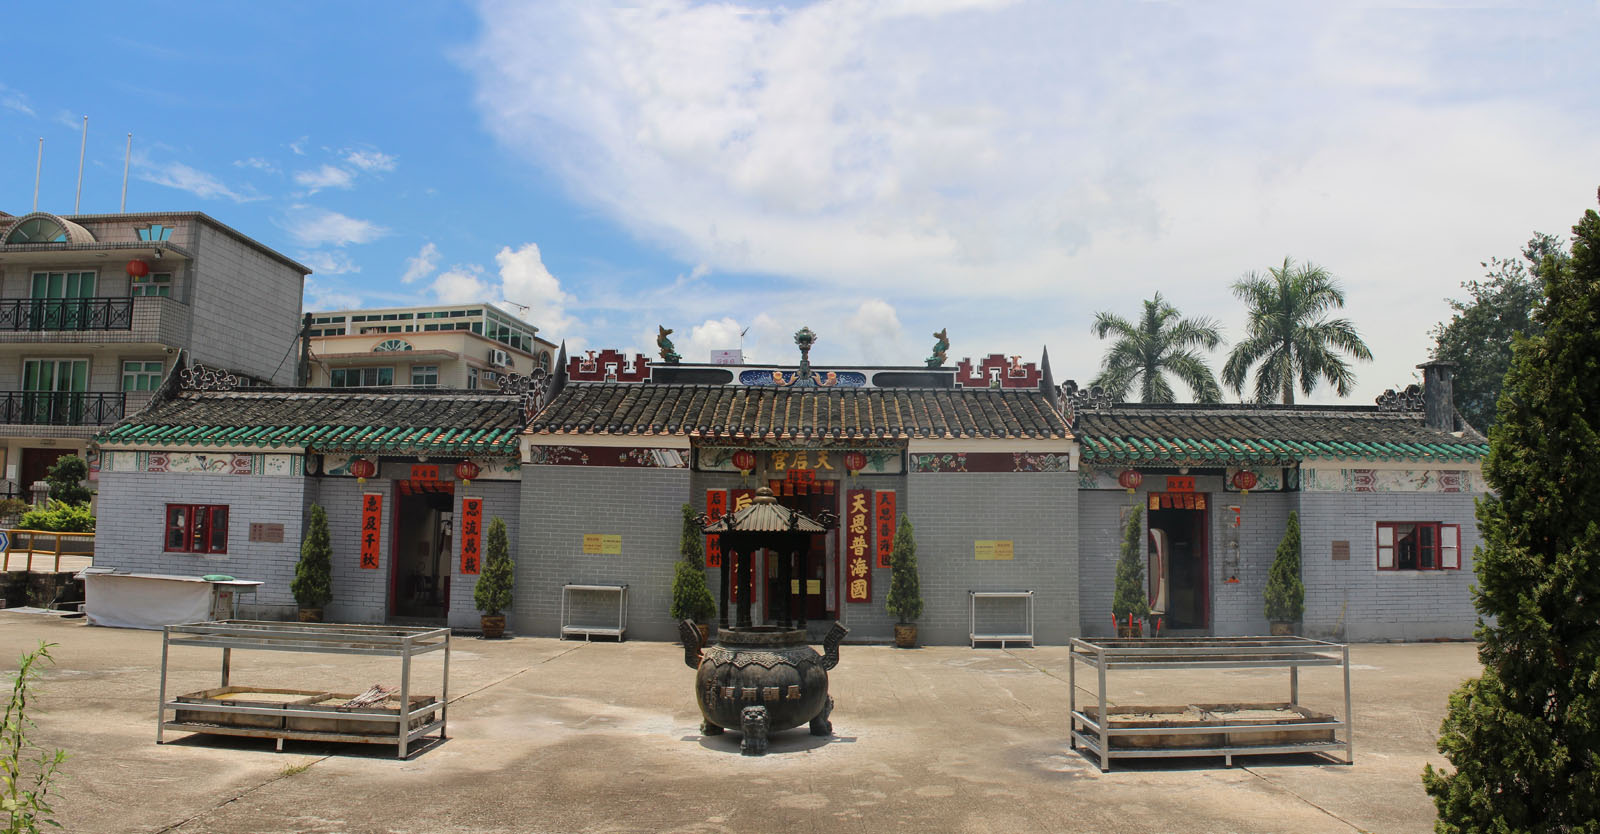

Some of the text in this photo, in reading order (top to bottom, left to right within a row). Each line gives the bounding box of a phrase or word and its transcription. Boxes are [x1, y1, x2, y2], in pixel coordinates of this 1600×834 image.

[771, 450, 834, 471] 天后宮
[363, 496, 378, 566] 惠及千秋
[850, 493, 869, 600] 天恩普海國
